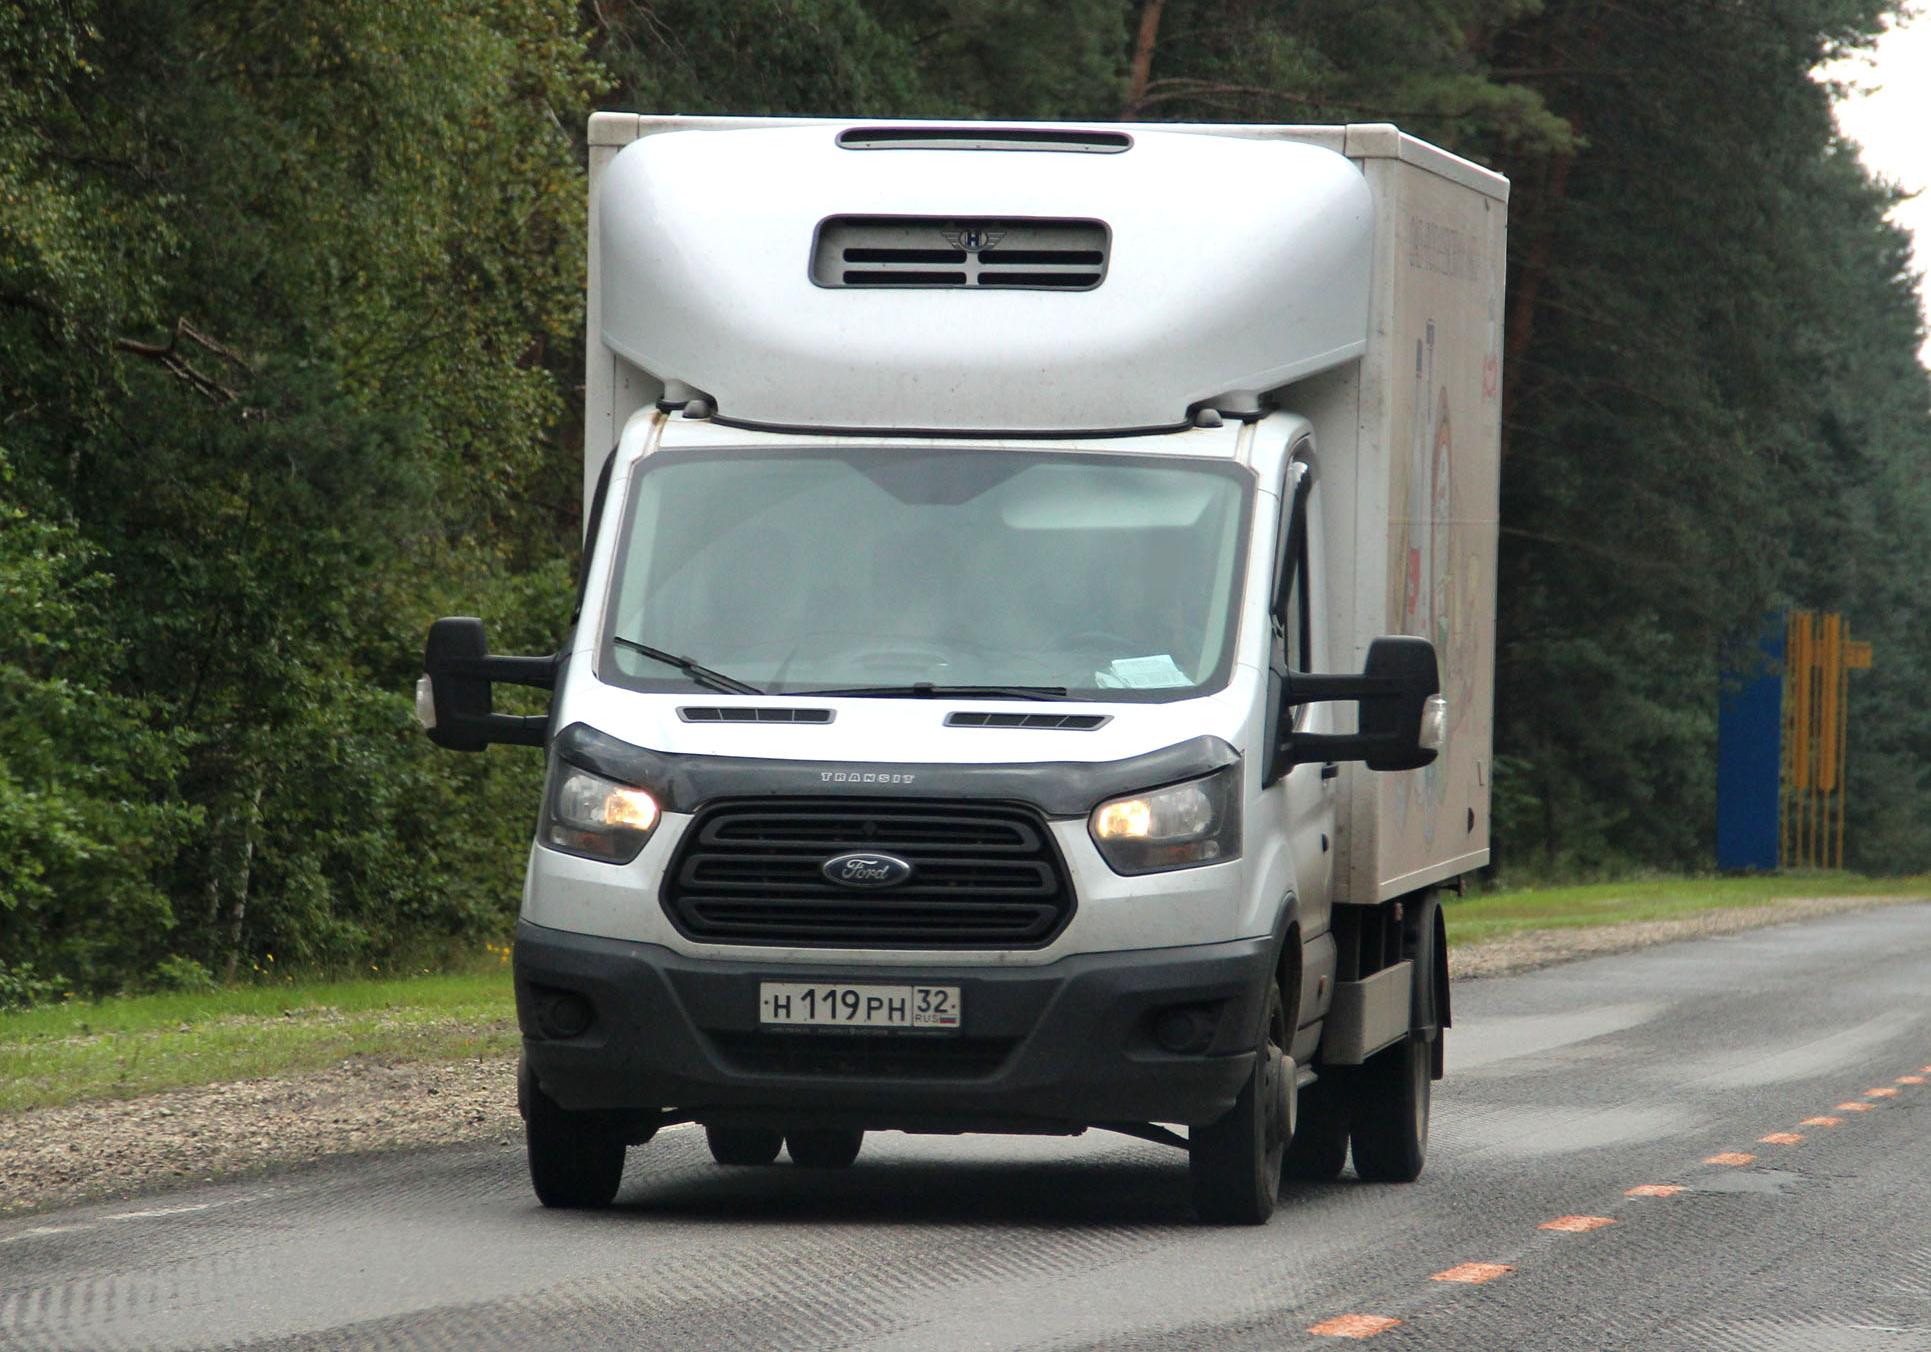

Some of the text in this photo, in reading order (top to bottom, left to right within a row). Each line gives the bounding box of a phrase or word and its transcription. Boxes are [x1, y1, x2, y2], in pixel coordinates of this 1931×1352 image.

[820, 772, 915, 784] TRANSIT
[841, 858, 890, 880] Ford
[917, 989, 948, 1013] 32
[915, 1014, 939, 1024] RUS
